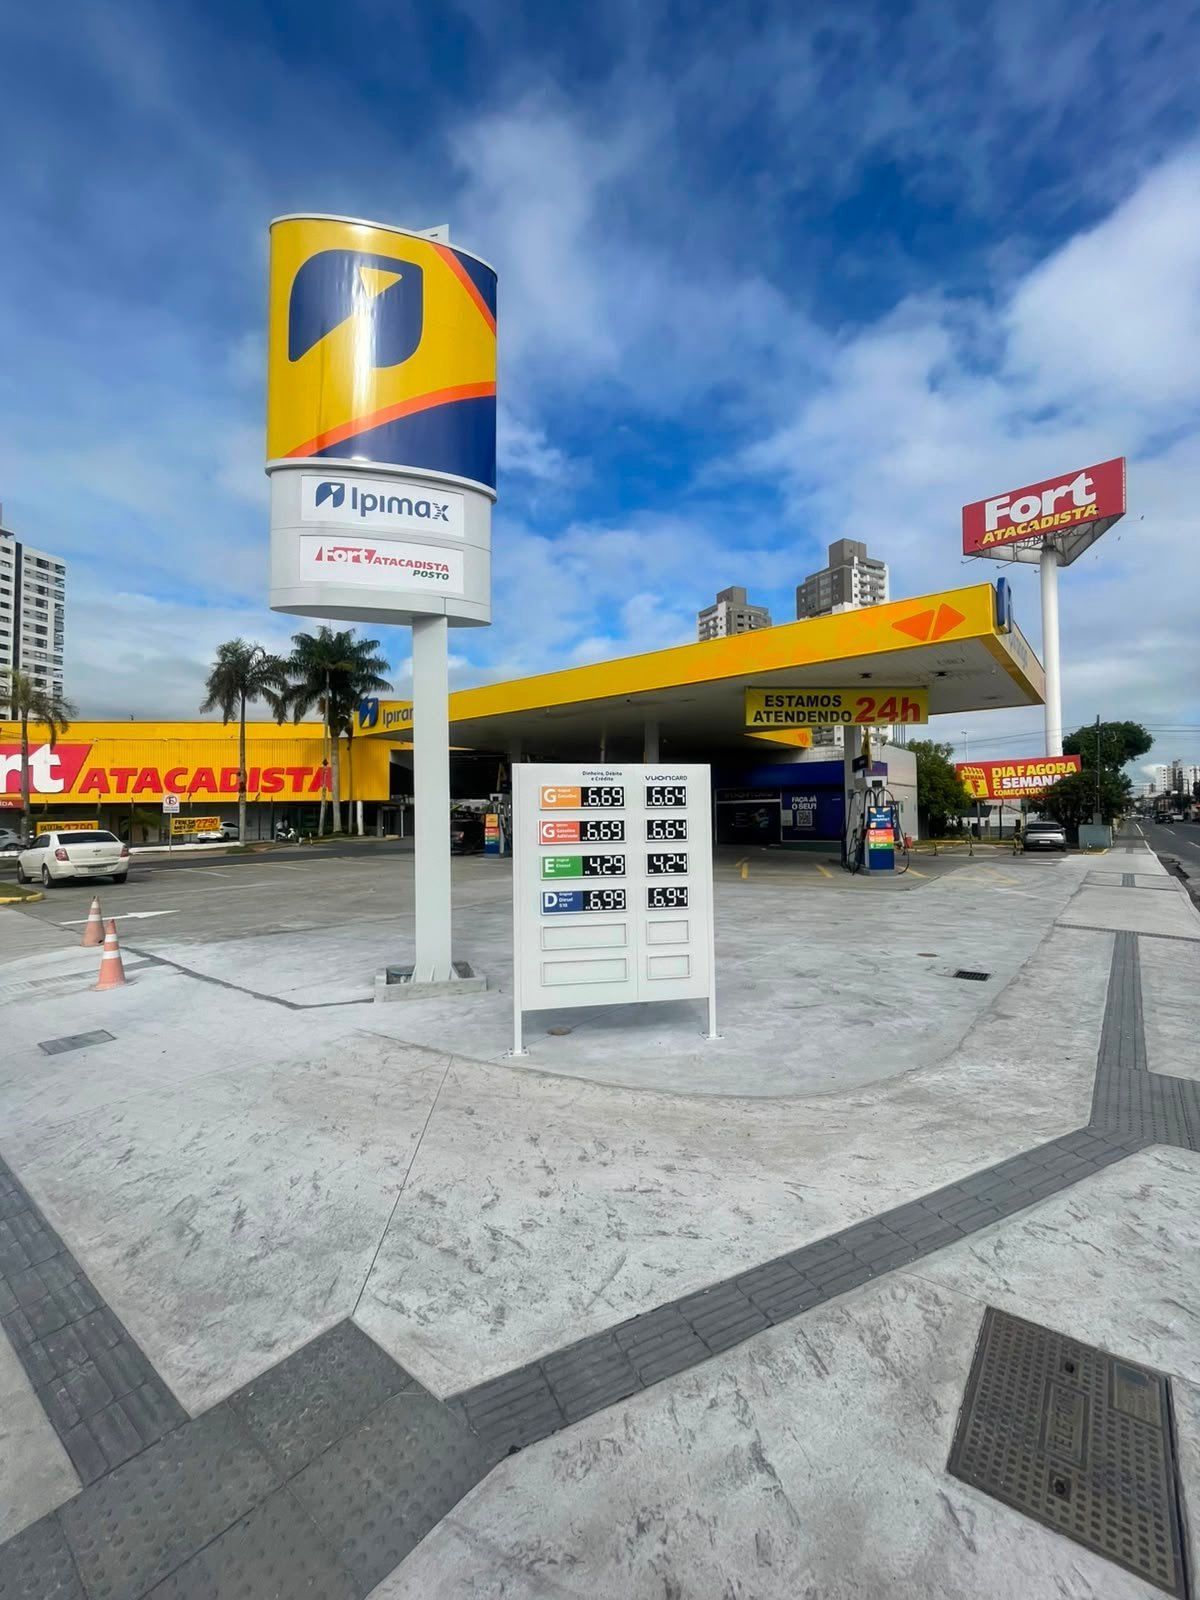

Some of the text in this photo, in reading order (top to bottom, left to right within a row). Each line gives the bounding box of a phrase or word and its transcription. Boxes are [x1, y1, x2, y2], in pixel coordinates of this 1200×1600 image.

[351, 486, 449, 522] Ipimax
[985, 472, 1096, 532] Fort
[982, 503, 1098, 545] ATACADISTA
[322, 546, 449, 572] Fort ATACADISTA
[413, 569, 449, 581] POSTO
[764, 694, 842, 708] ESTAMOS
[854, 696, 921, 723] 24h
[753, 710, 852, 723] ATENDENDO
[992, 761, 1077, 778] DIA F AGORA
[78, 767, 332, 794] ATACADISTA
[543, 788, 557, 803] G
[588, 788, 622, 806] 6,69
[652, 787, 685, 806] 6,64
[993, 788, 1025, 797] COMEÇA
[542, 823, 555, 838] G
[587, 821, 622, 840] 6,69
[653, 820, 686, 839] 6,64
[544, 858, 555, 873] E
[590, 856, 624, 875] 4,29
[653, 854, 687, 873] 4,24
[544, 893, 558, 908] D
[590, 890, 625, 909] 6,99
[654, 888, 687, 907] 6,94
